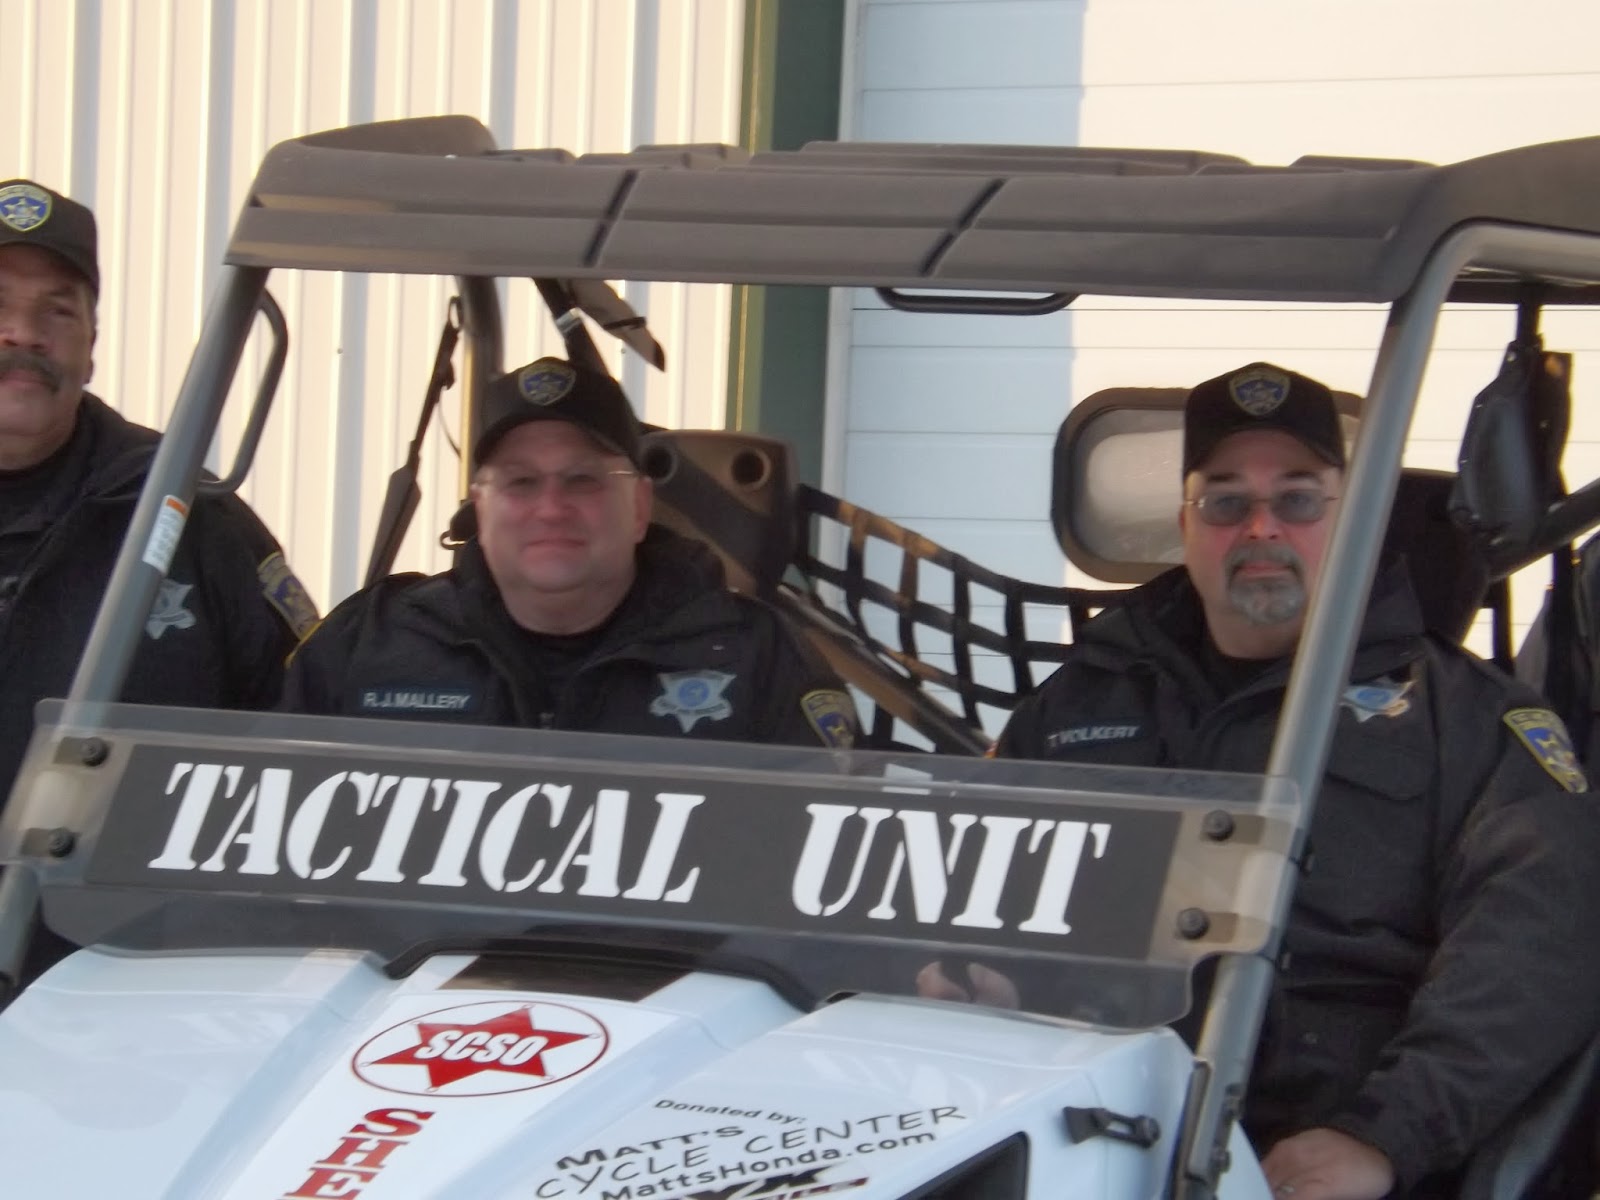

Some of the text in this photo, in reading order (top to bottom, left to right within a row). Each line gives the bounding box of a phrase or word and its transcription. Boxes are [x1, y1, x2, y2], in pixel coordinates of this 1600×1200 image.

[149, 762, 1110, 935] TACTICAL UNIT
[414, 1030, 548, 1066] SCSO
[654, 1099, 806, 1126] Donated by:
[535, 1146, 710, 1200] CYCLE
[744, 1106, 967, 1154] CENTER
[556, 1126, 744, 1170] MATT'S
[601, 1132, 935, 1200] MattsHonda.com
